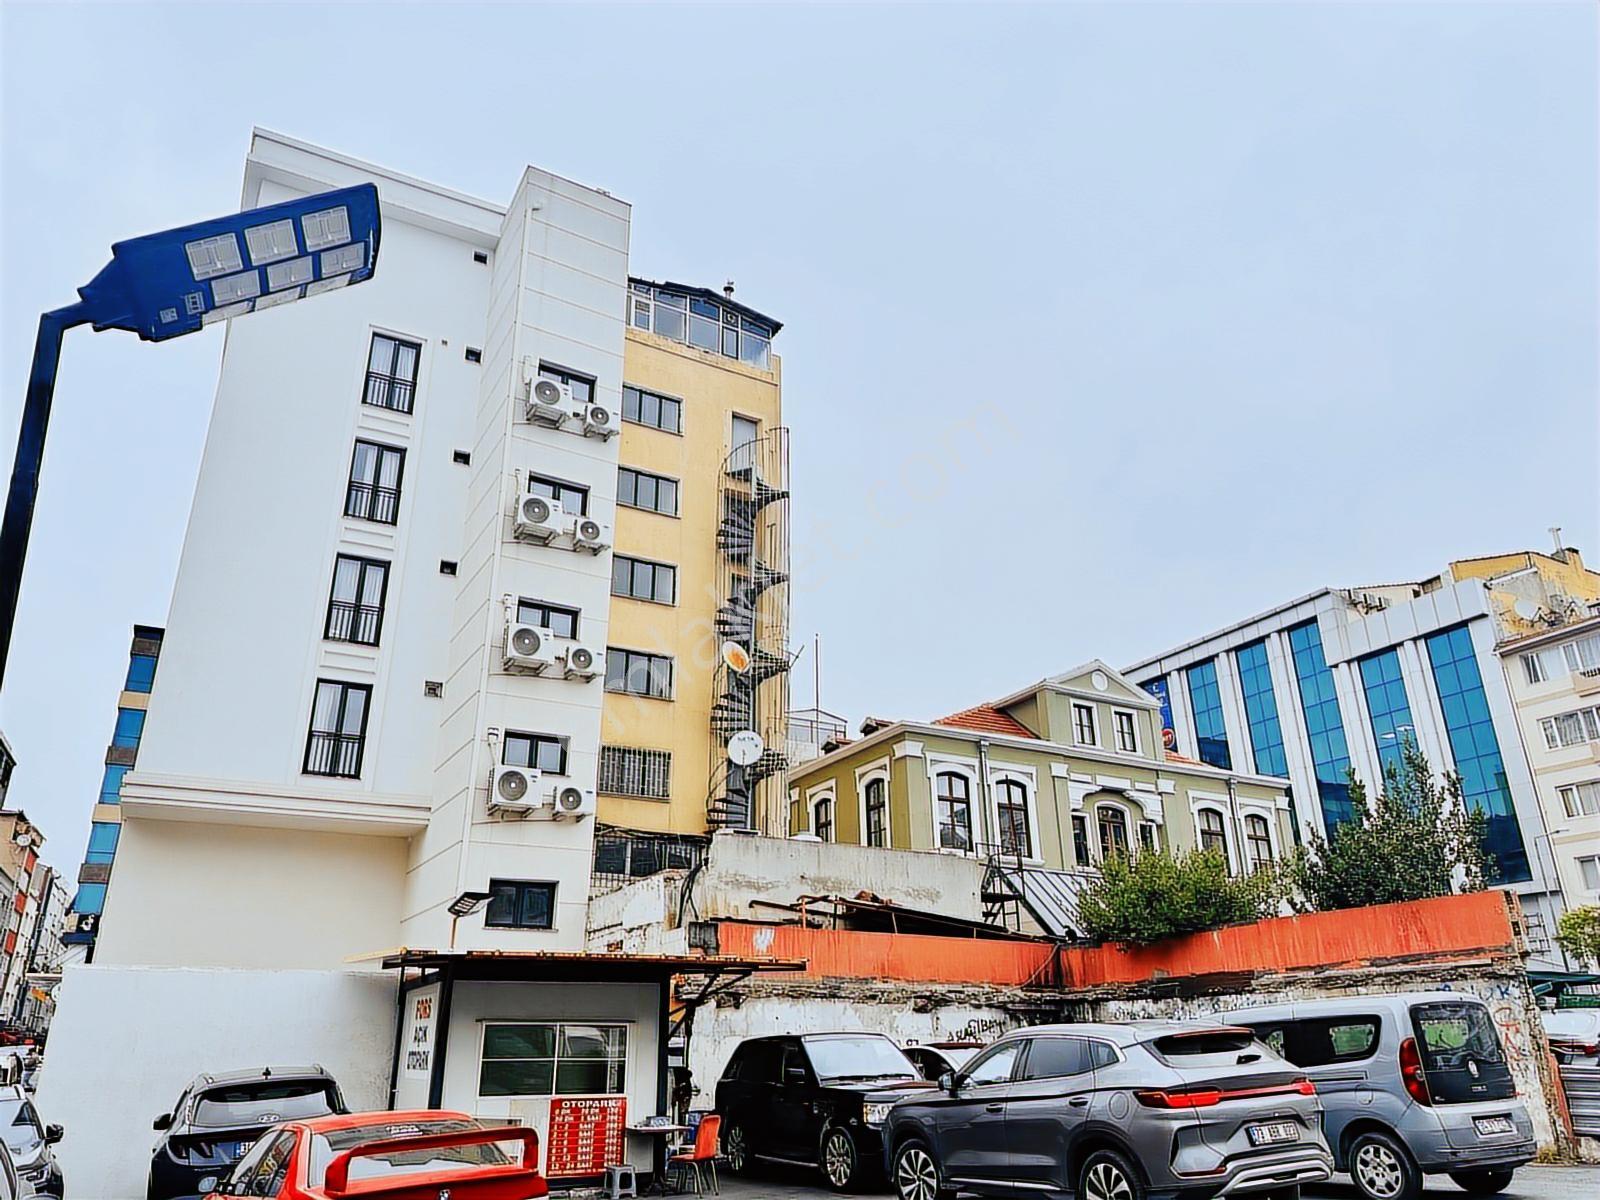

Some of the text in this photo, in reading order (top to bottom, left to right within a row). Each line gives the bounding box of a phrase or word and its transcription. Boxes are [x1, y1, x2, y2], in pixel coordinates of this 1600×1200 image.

[562, 1100, 620, 1108] OTOPARK
[579, 1122, 595, 1130] SAAT
[577, 1145, 593, 1153] SAAT
[577, 1153, 593, 1161] SAAT
[576, 1161, 593, 1169] SAAT
